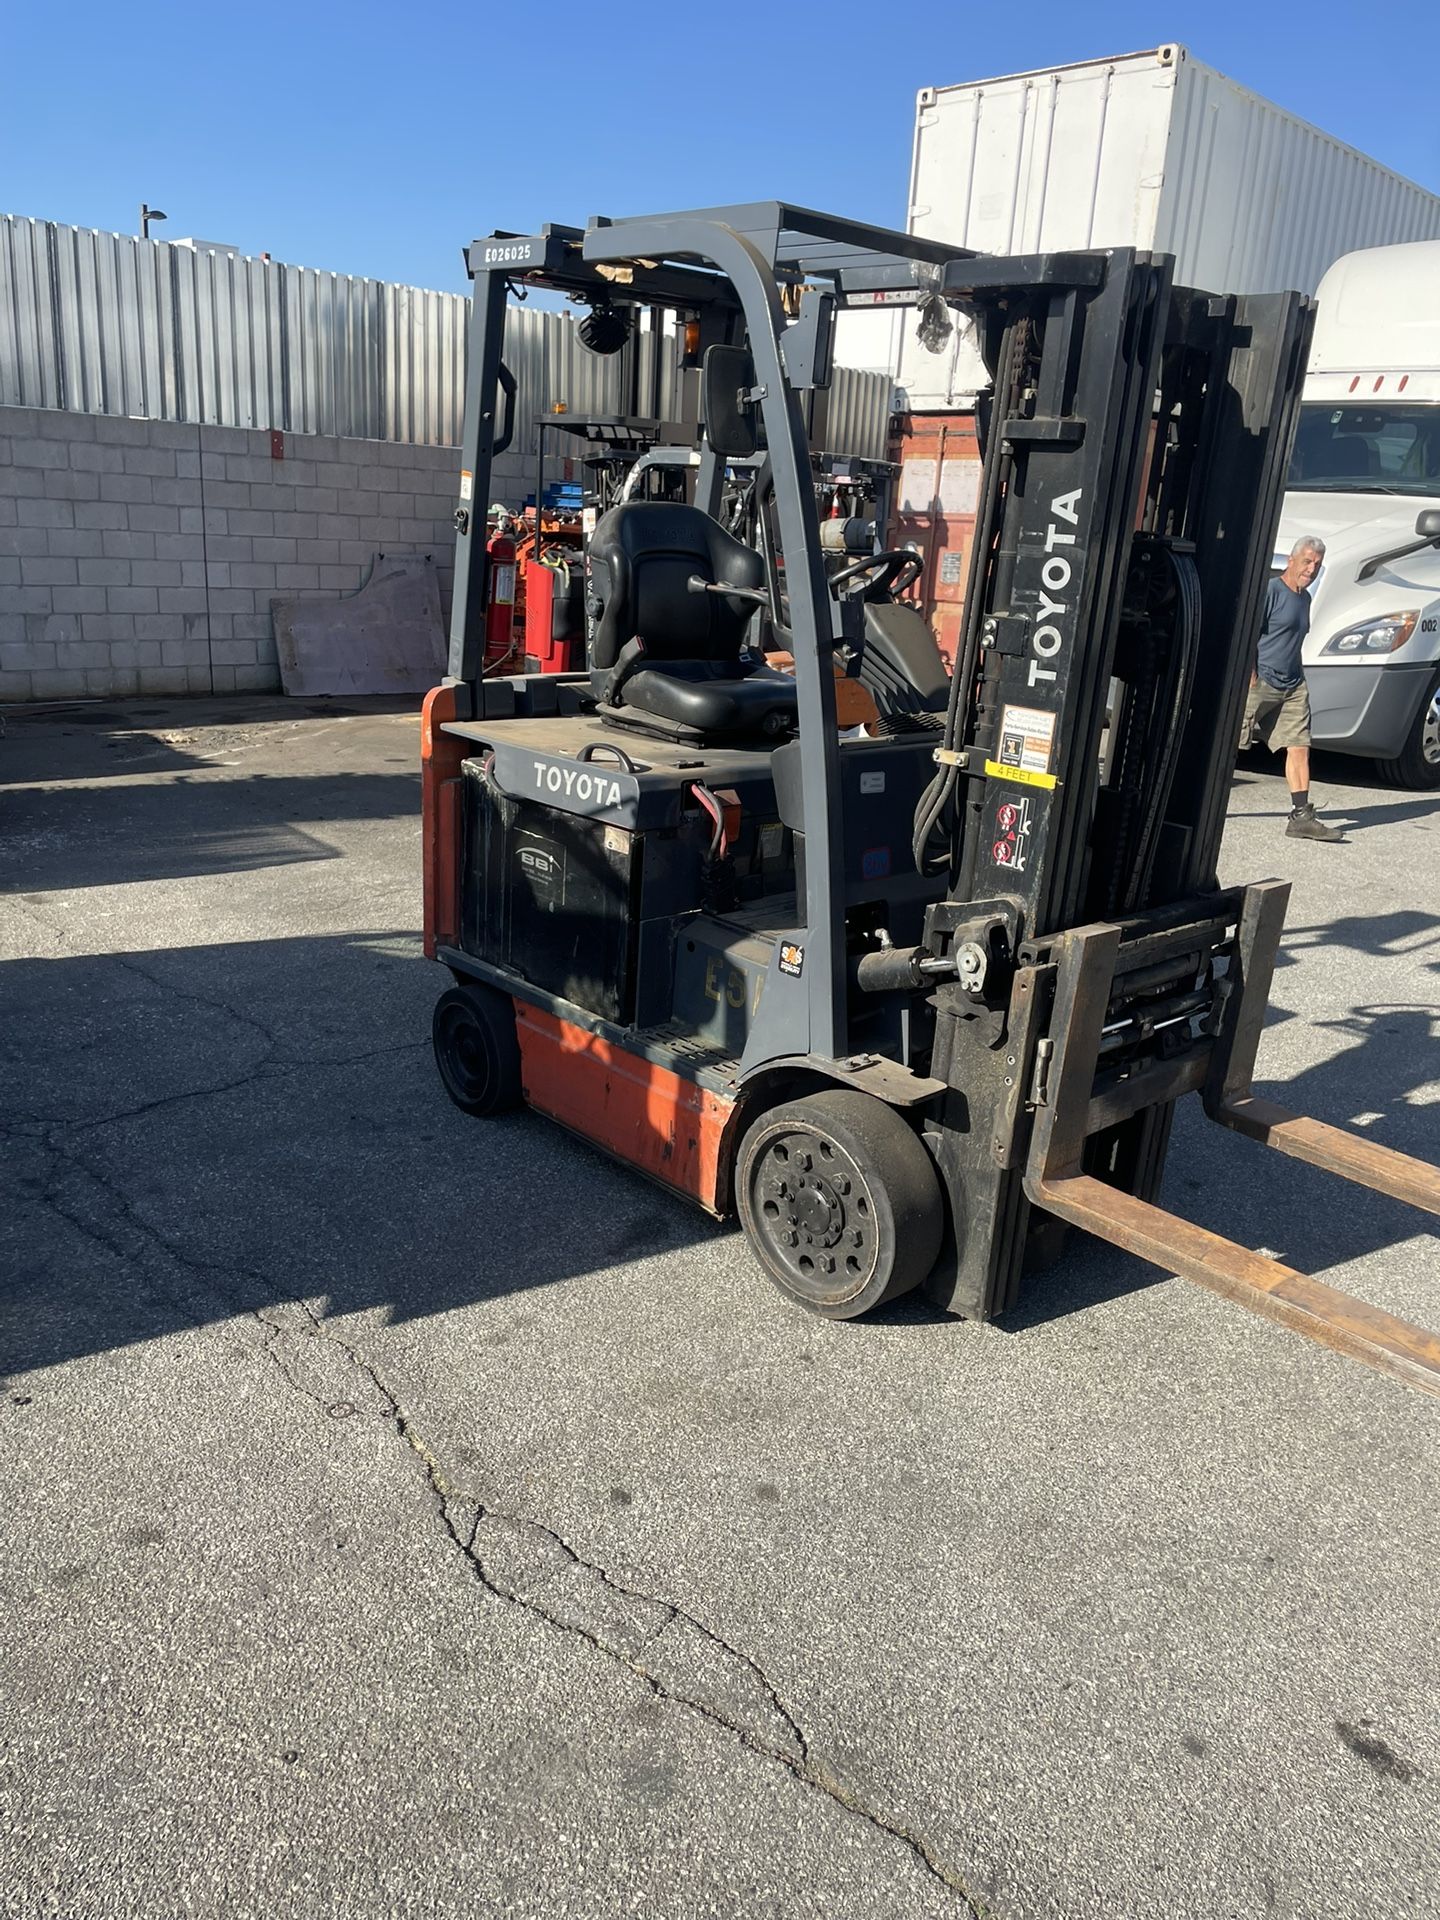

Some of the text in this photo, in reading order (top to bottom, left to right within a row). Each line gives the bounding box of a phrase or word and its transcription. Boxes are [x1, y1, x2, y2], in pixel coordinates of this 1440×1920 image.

[485, 244, 531, 263] E026025
[1027, 488, 1083, 687] TOYOTA
[1421, 619, 1438, 632] 002
[997, 766, 1033, 782] 4 FEET
[533, 761, 623, 810] TOYOTA
